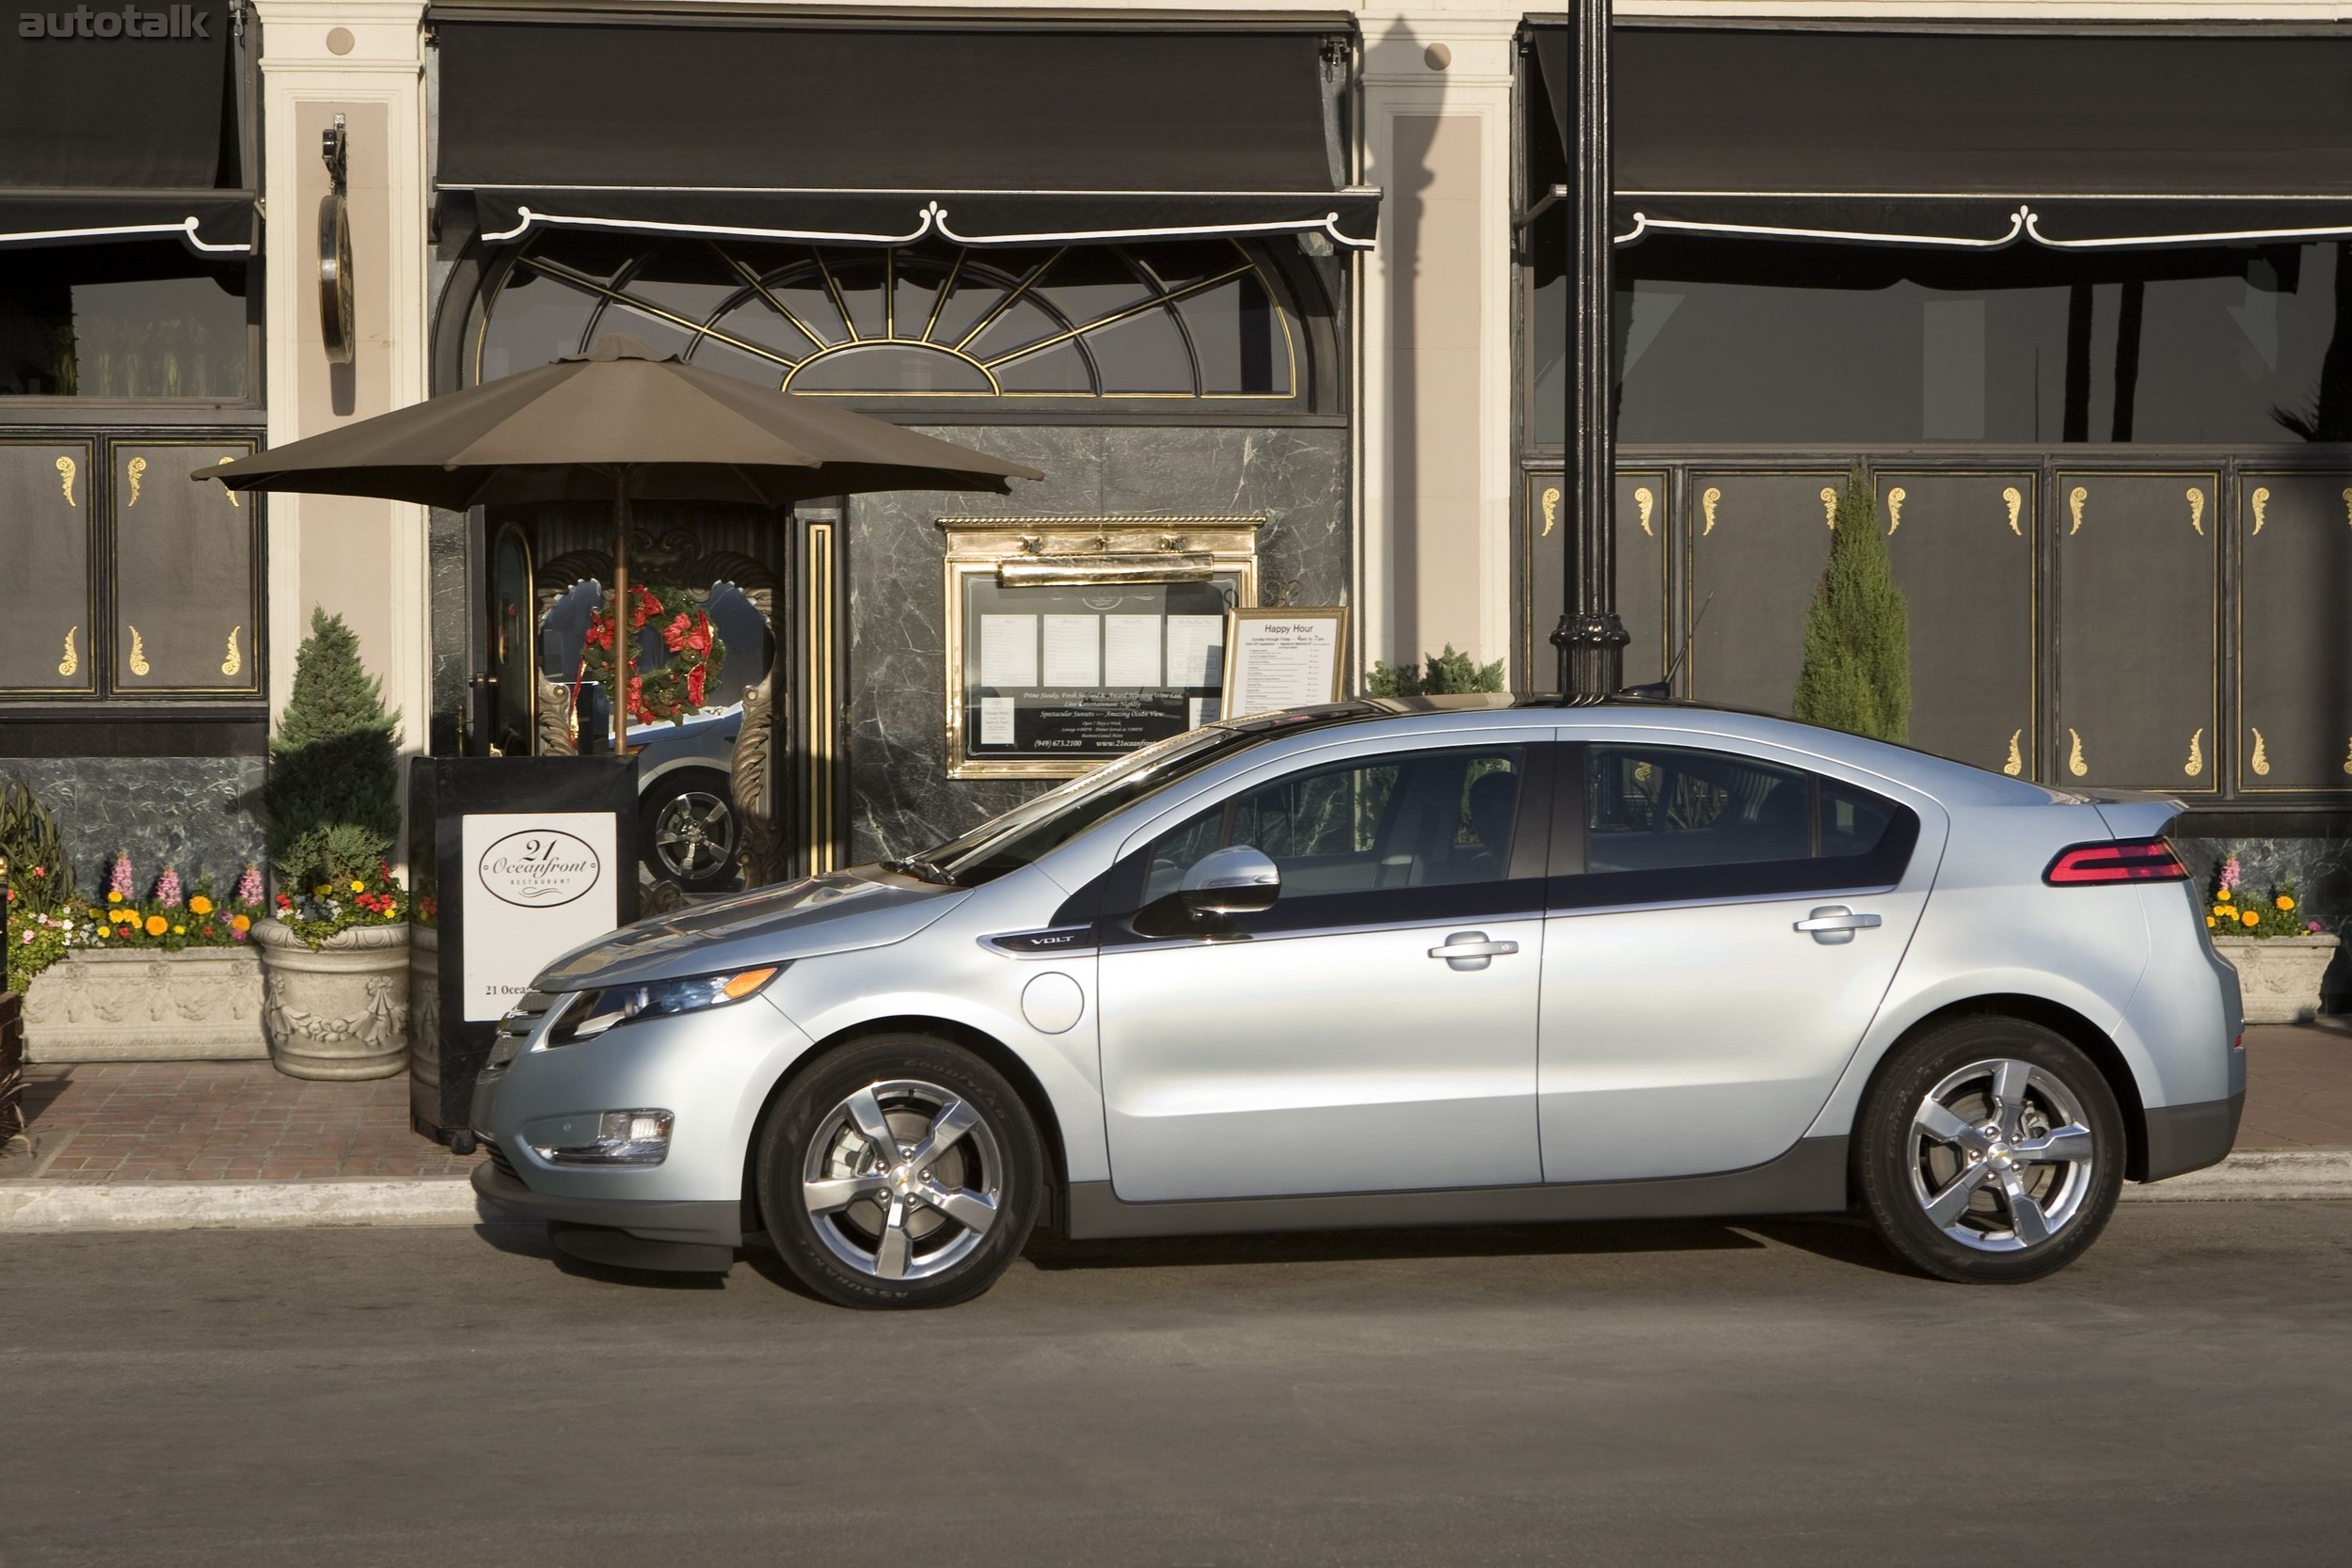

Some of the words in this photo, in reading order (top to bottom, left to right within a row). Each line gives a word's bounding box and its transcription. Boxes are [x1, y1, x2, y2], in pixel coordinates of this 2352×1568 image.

[1264, 624, 1292, 635] Happy
[1293, 624, 1314, 633] Hour
[1040, 710, 1073, 719] Spectacular
[1104, 710, 1130, 719] Amazing
[1034, 739, 1052, 749] (949)
[520, 839, 559, 862] 21
[492, 857, 588, 879] Oceanfront
[1030, 935, 1075, 944] VOLT
[485, 985, 498, 995] 21
[501, 985, 531, 995] Ocea
